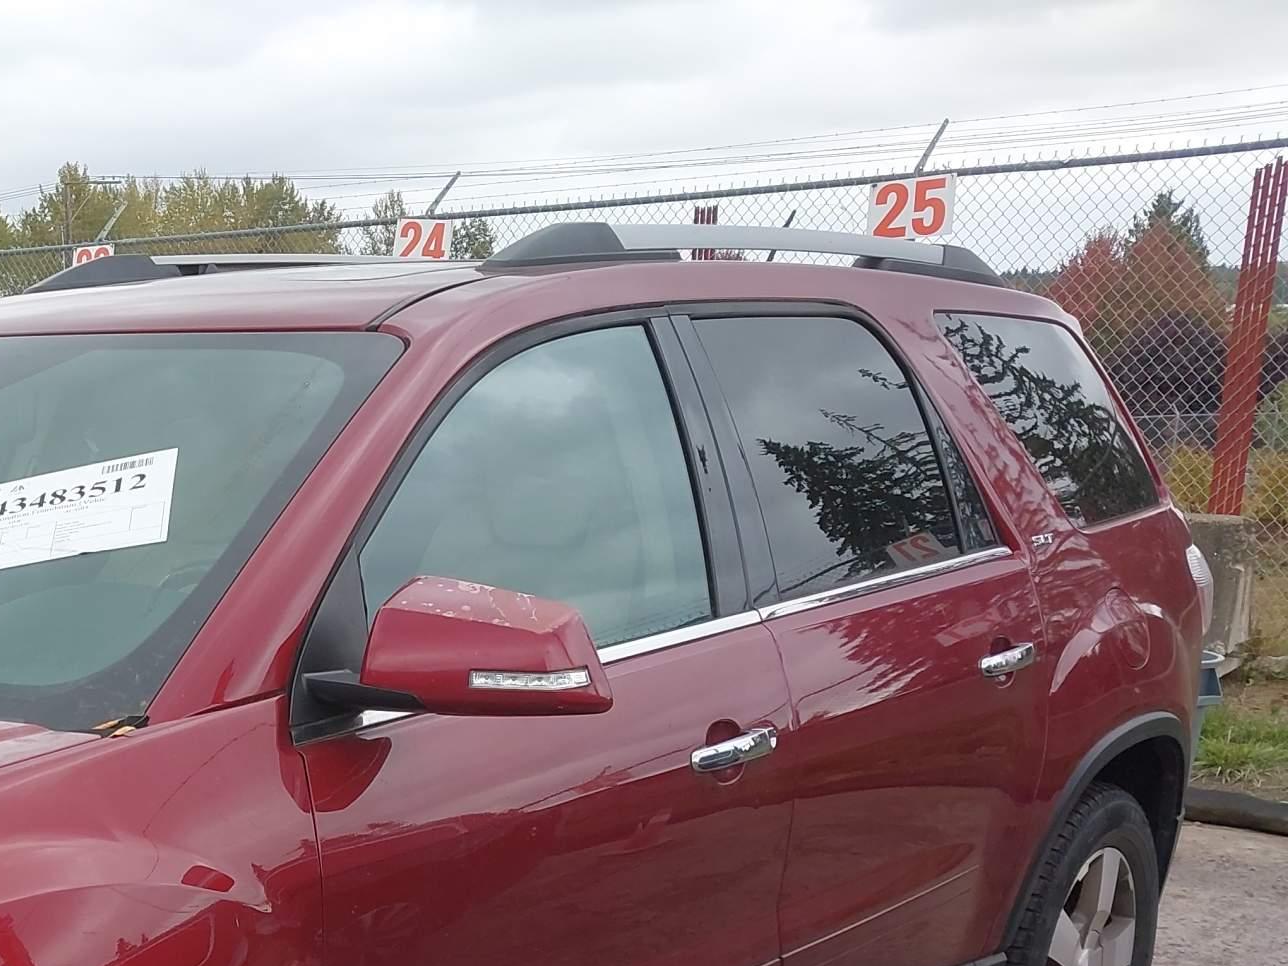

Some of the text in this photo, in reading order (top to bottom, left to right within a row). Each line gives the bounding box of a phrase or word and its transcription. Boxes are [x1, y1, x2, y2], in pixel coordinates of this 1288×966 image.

[872, 177, 947, 239] 25
[399, 221, 446, 259] 24
[1031, 532, 1054, 547] SLT
